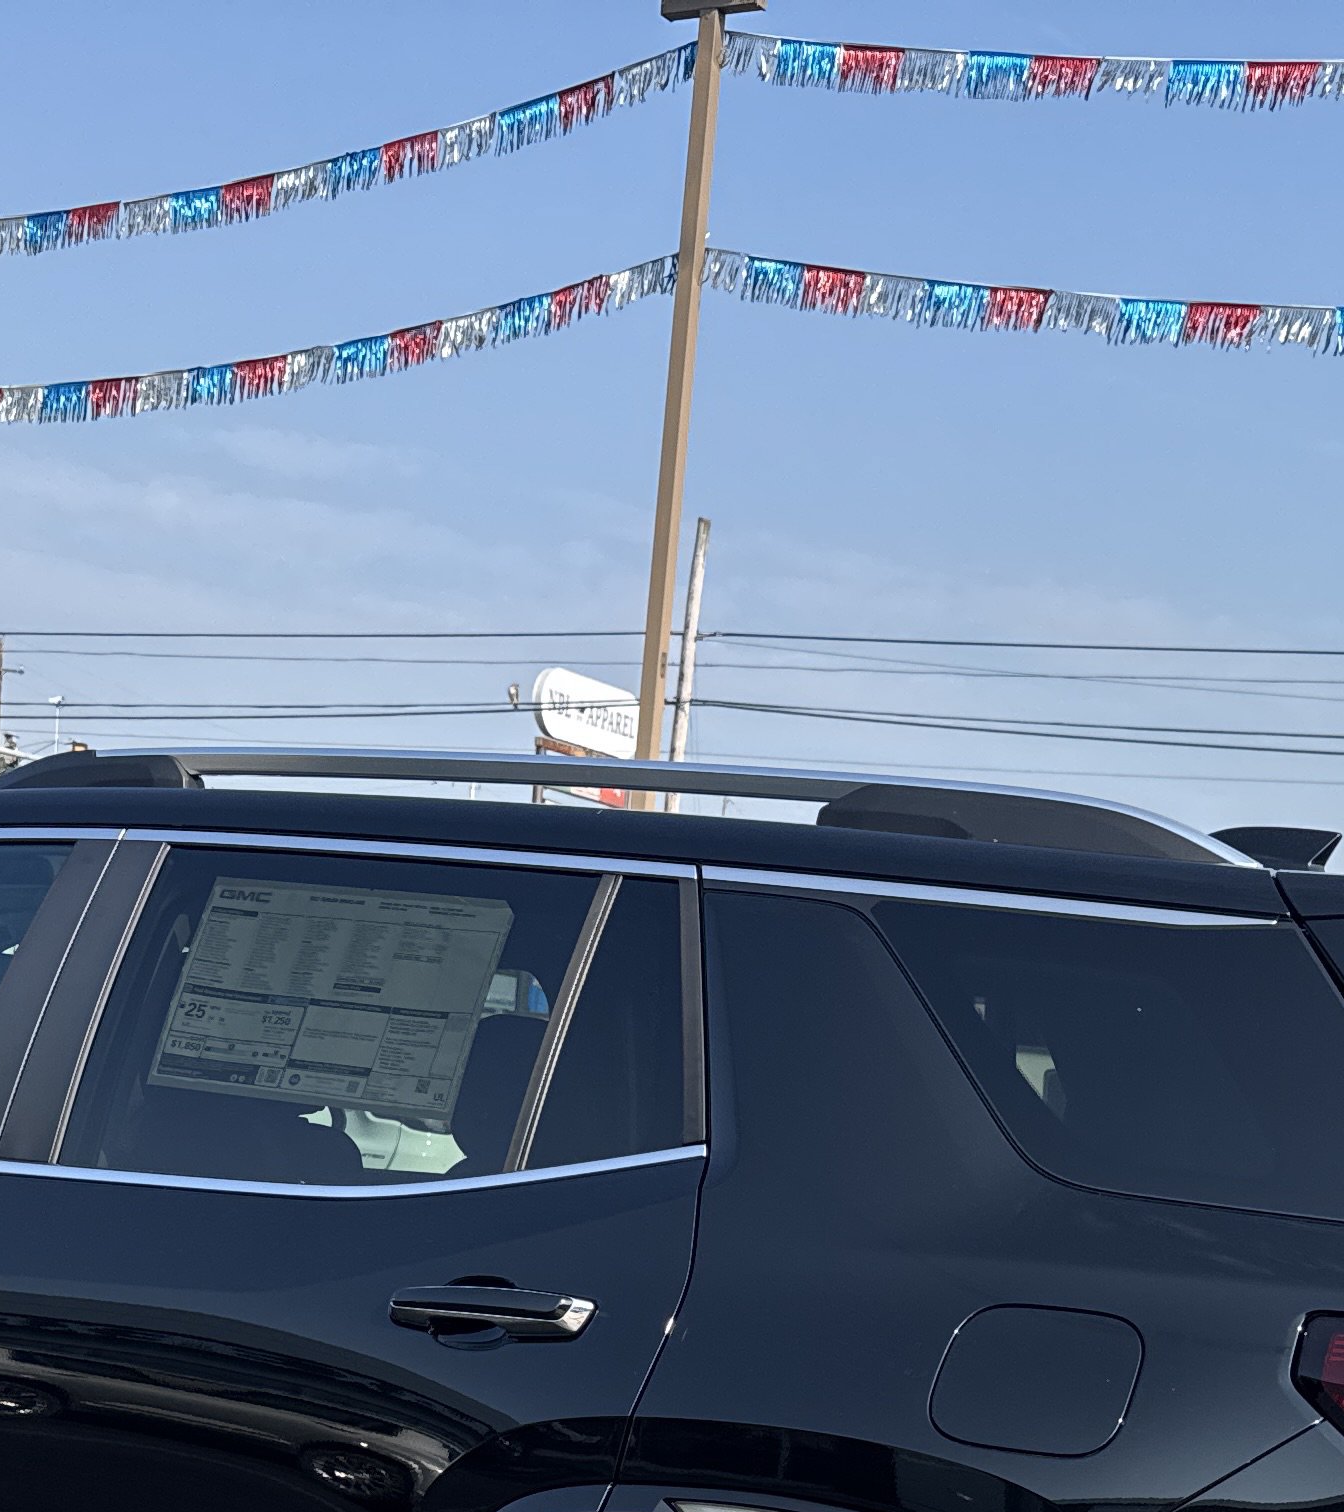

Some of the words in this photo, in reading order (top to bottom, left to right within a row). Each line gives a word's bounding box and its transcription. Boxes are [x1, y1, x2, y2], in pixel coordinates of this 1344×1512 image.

[586, 706, 635, 739] APPAREL
[219, 889, 272, 903] GMC
[184, 1003, 208, 1019] 25
